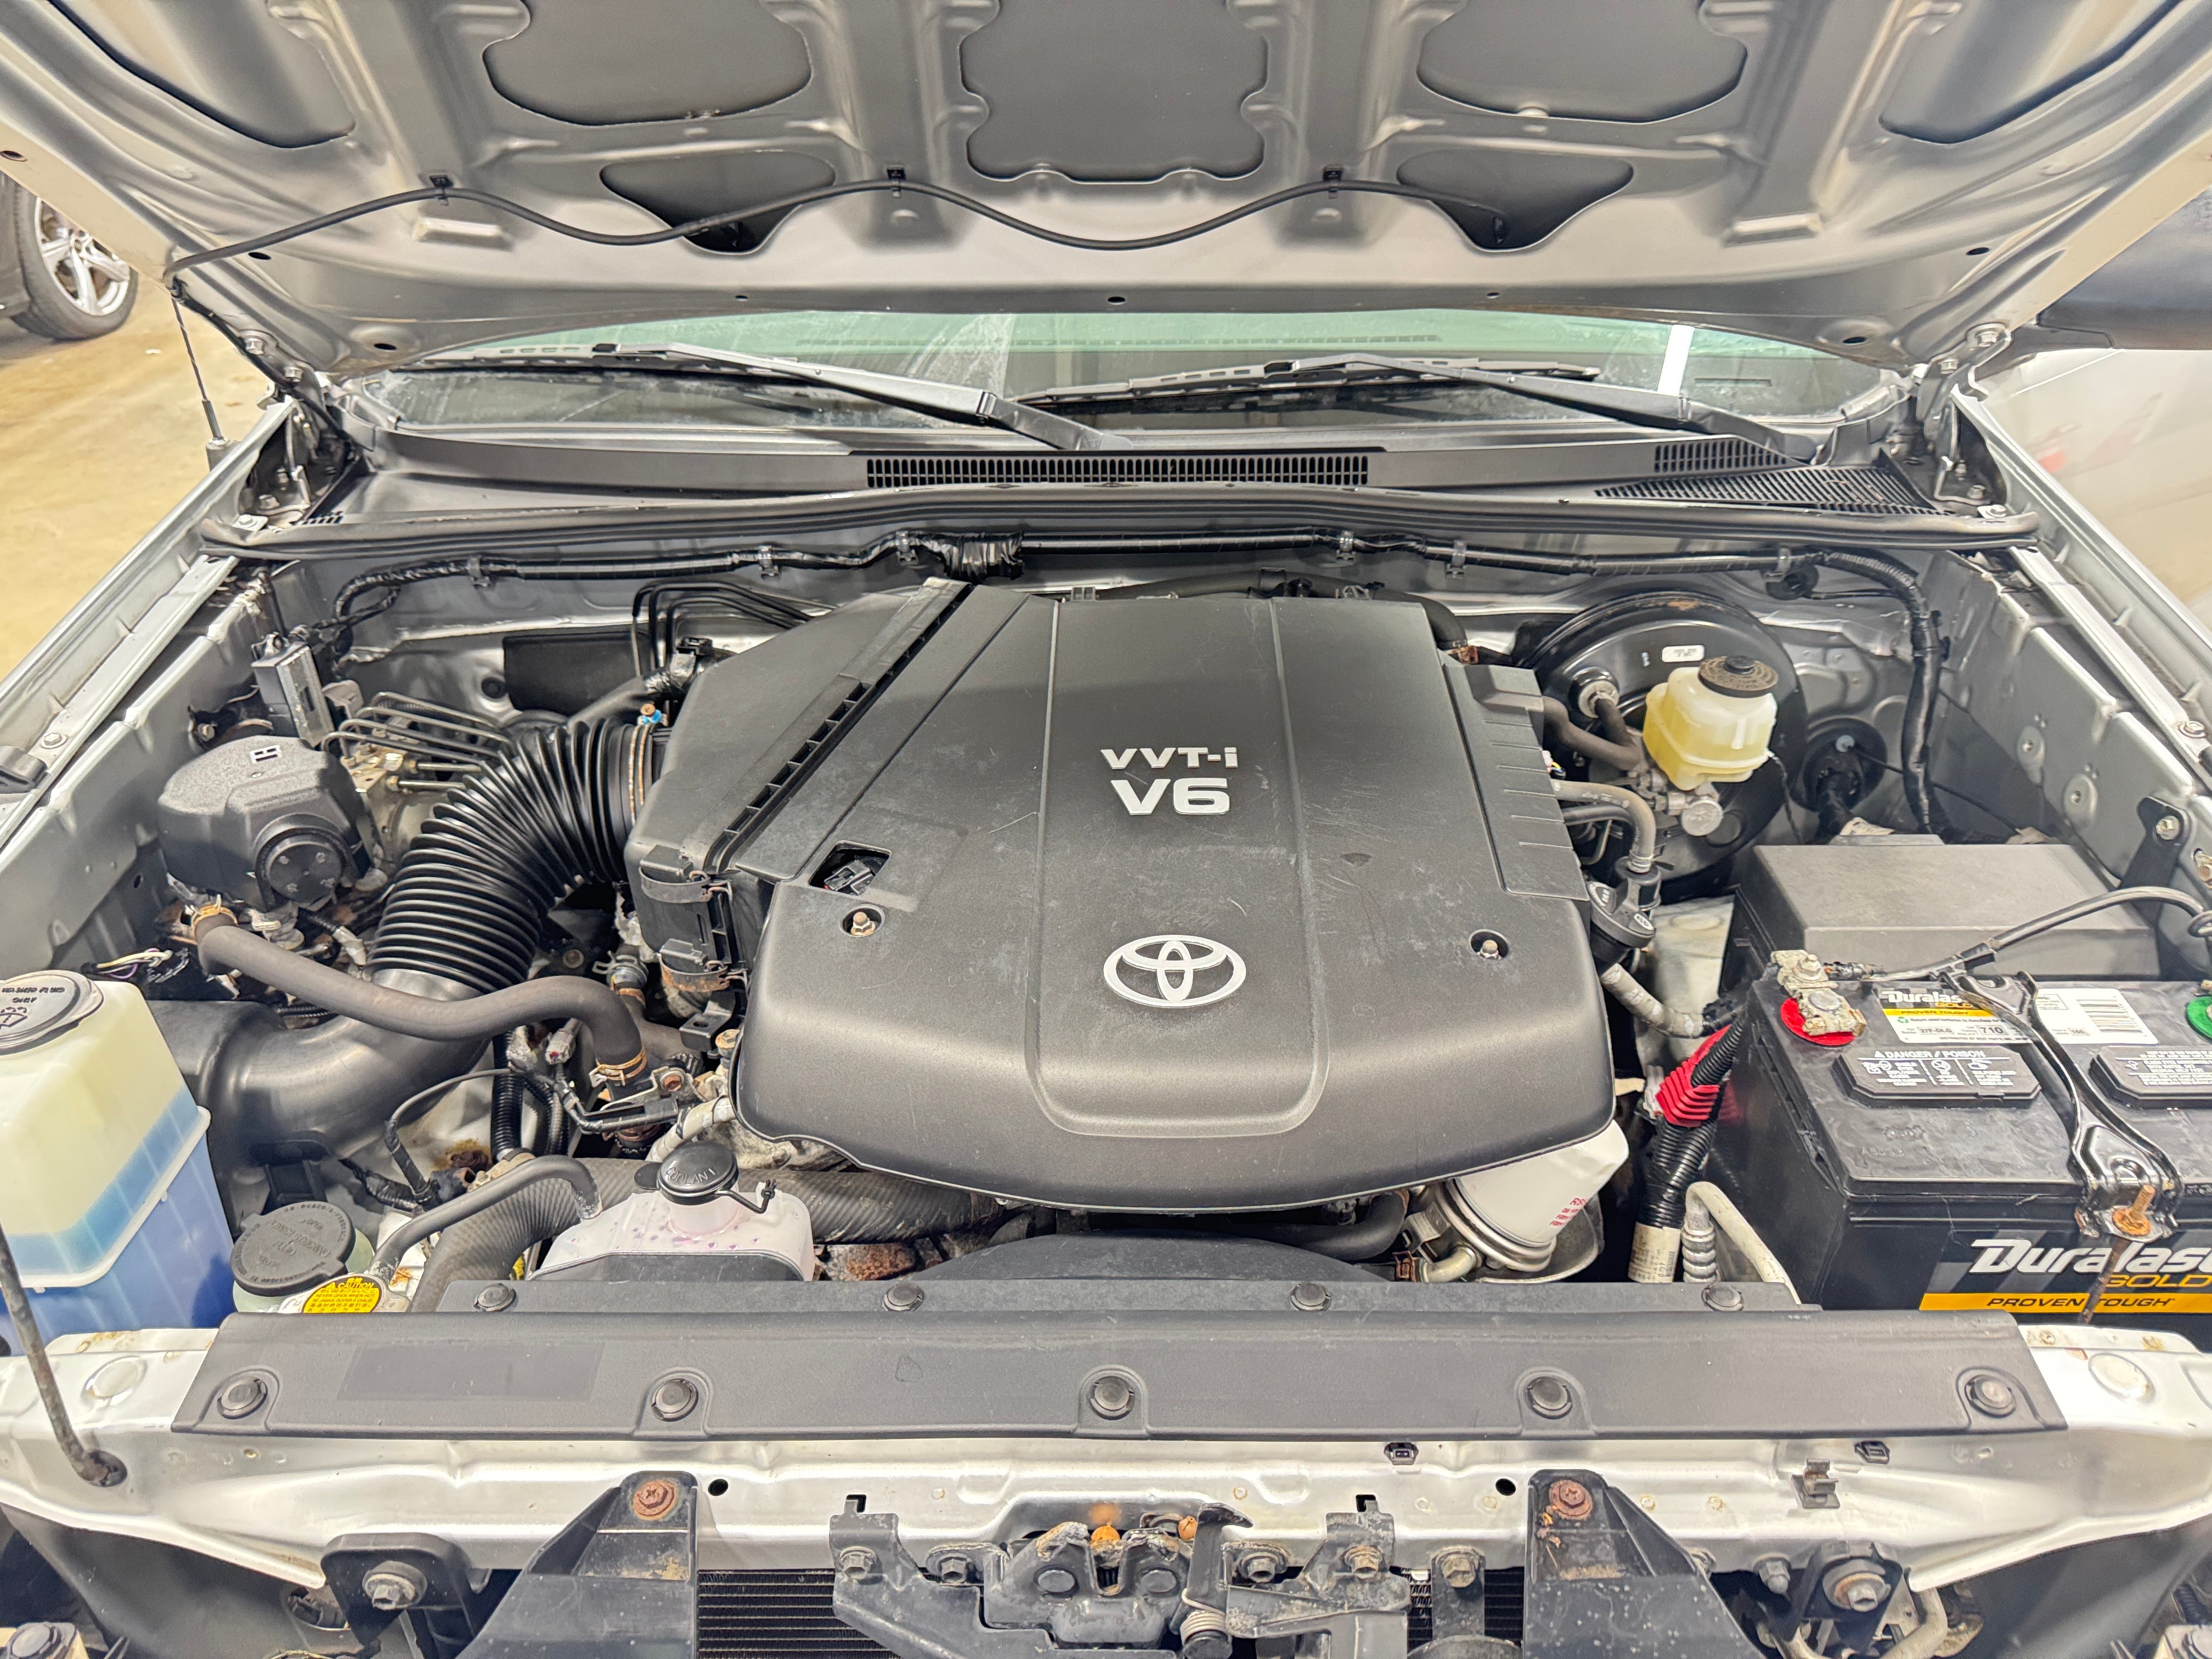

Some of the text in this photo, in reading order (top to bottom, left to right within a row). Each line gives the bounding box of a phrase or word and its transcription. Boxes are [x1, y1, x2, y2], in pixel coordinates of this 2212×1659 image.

[1101, 747, 1238, 769] VVT-i
[1110, 777, 1230, 815] V6
[1881, 990, 1968, 1003] Duralas
[2106, 1274, 2212, 1288] GOLD
[1986, 1298, 2085, 1307] PROVEN
